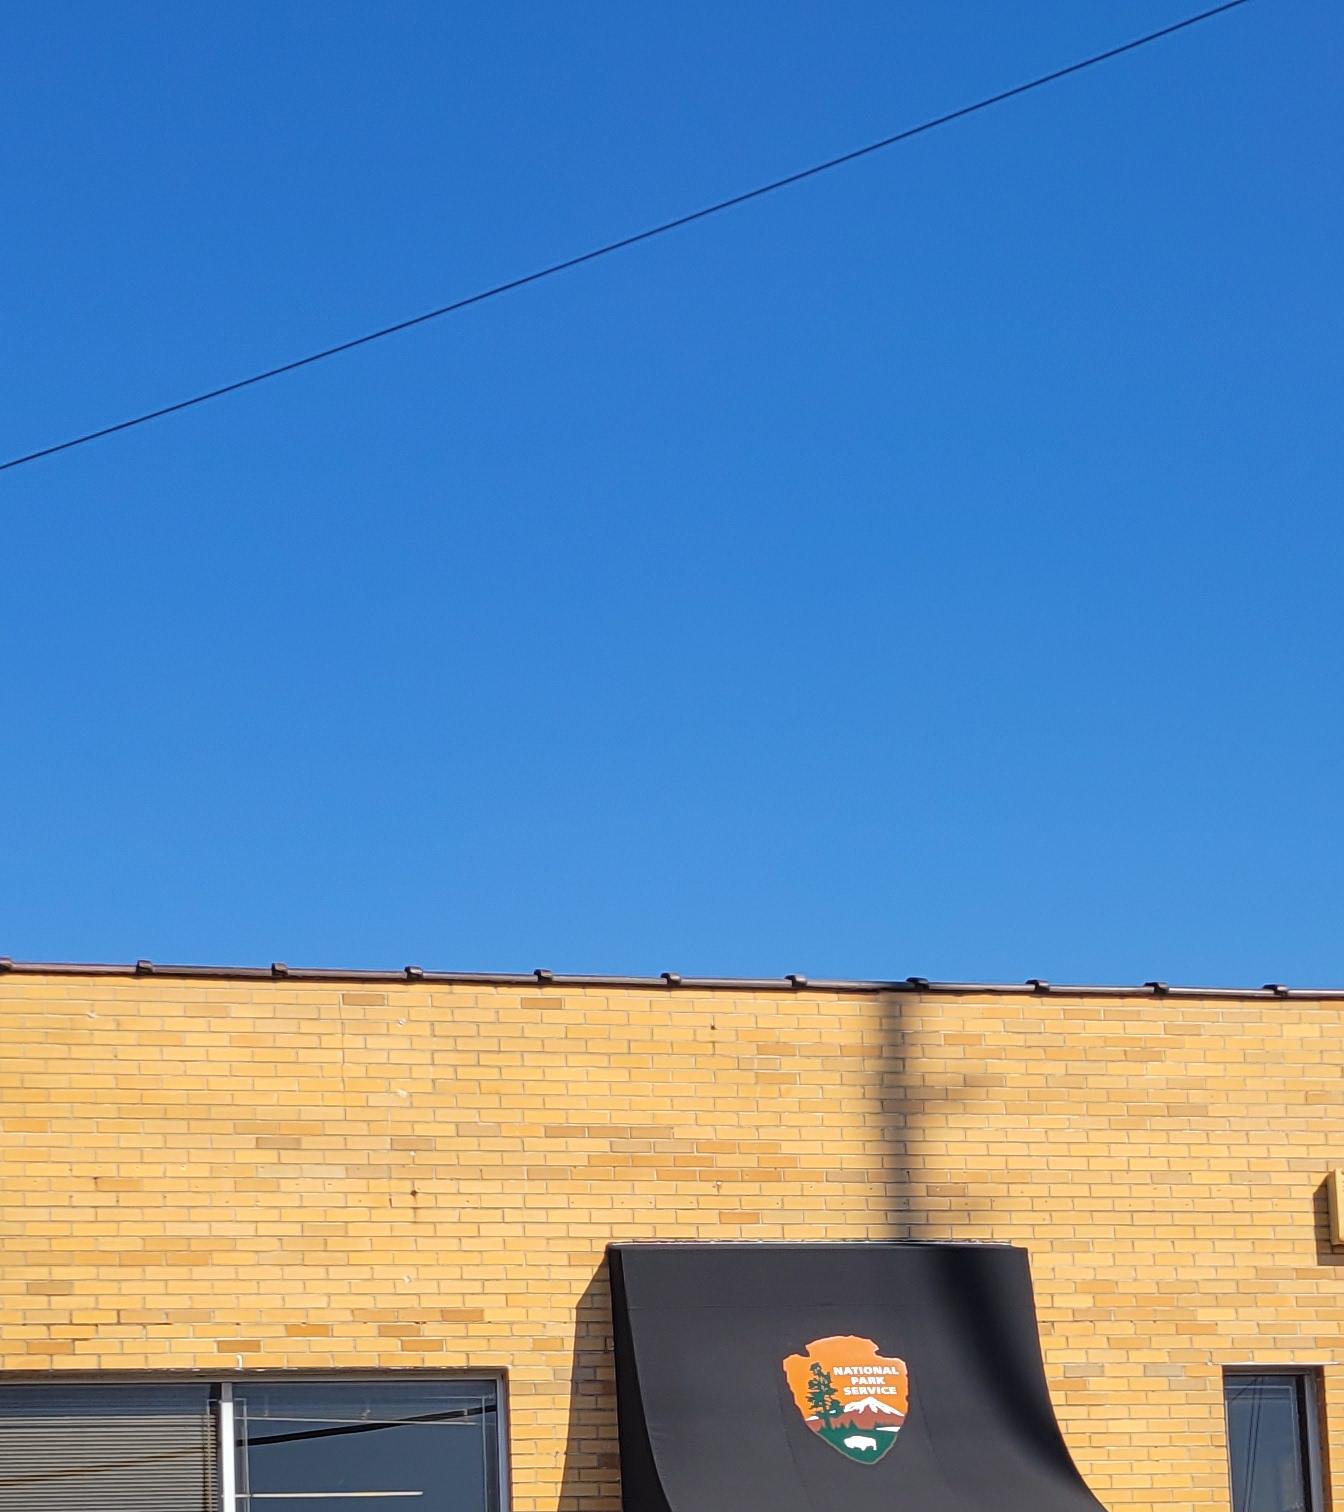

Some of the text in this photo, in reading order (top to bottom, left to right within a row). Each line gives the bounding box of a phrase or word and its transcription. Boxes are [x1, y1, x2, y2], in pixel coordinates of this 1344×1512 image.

[833, 1366, 899, 1375] NATIONAL
[850, 1376, 886, 1385] PARK
[843, 1386, 897, 1395] SERVICE
